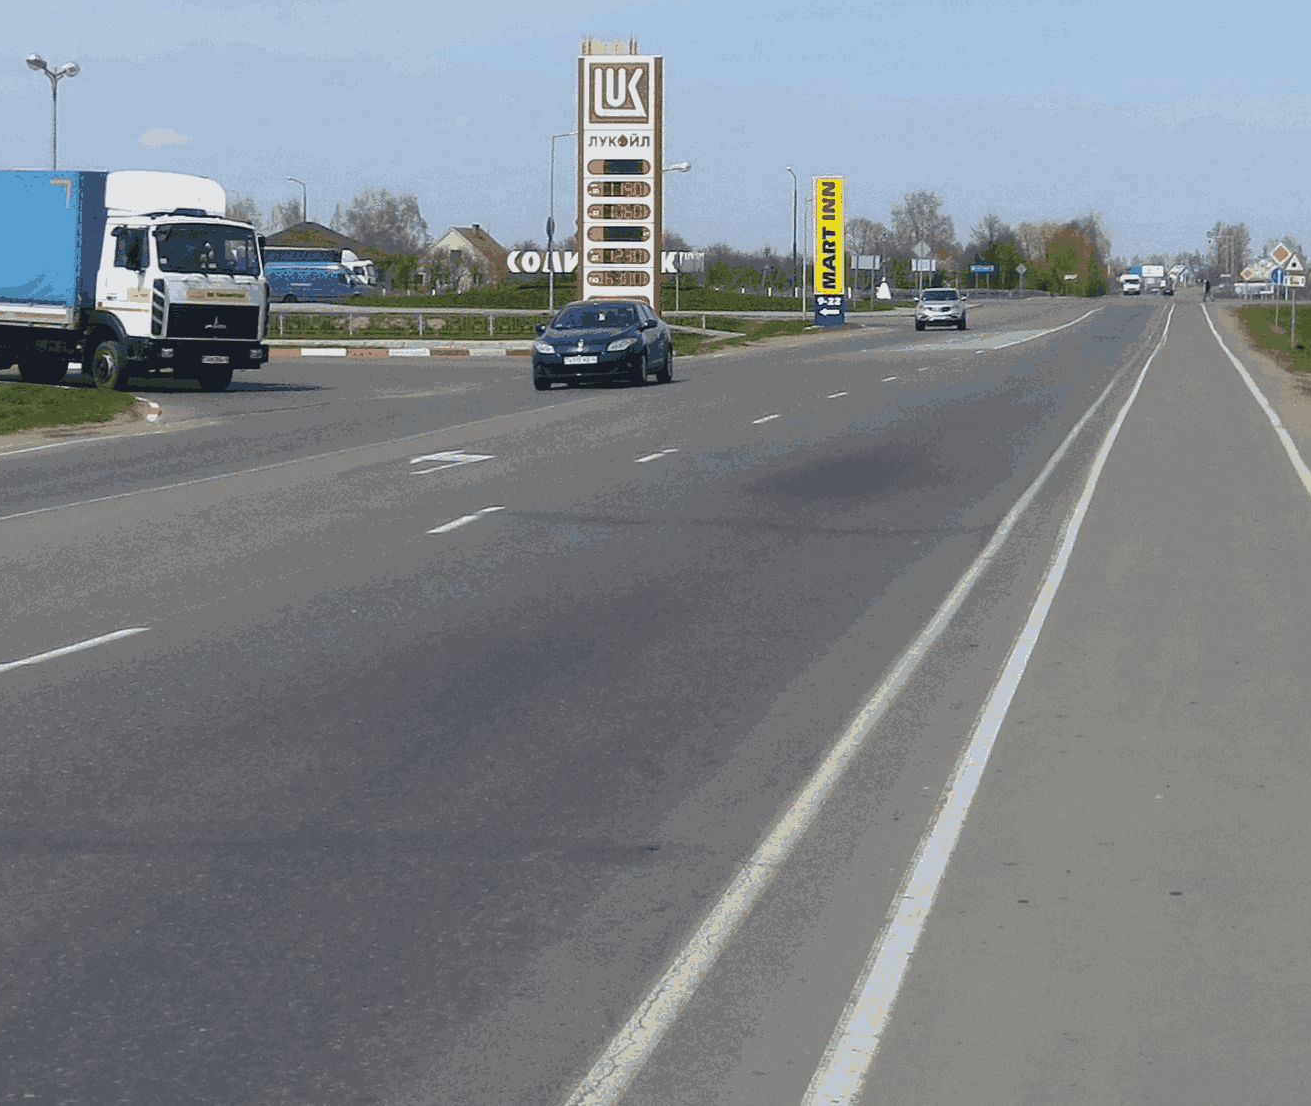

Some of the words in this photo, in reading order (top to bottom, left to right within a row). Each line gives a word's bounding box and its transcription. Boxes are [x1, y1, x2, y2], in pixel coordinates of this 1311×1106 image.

[588, 133, 651, 147] ЛУКОЙЛ
[822, 181, 835, 220] INN
[822, 226, 836, 289] MART
[817, 296, 842, 306] 9-22
